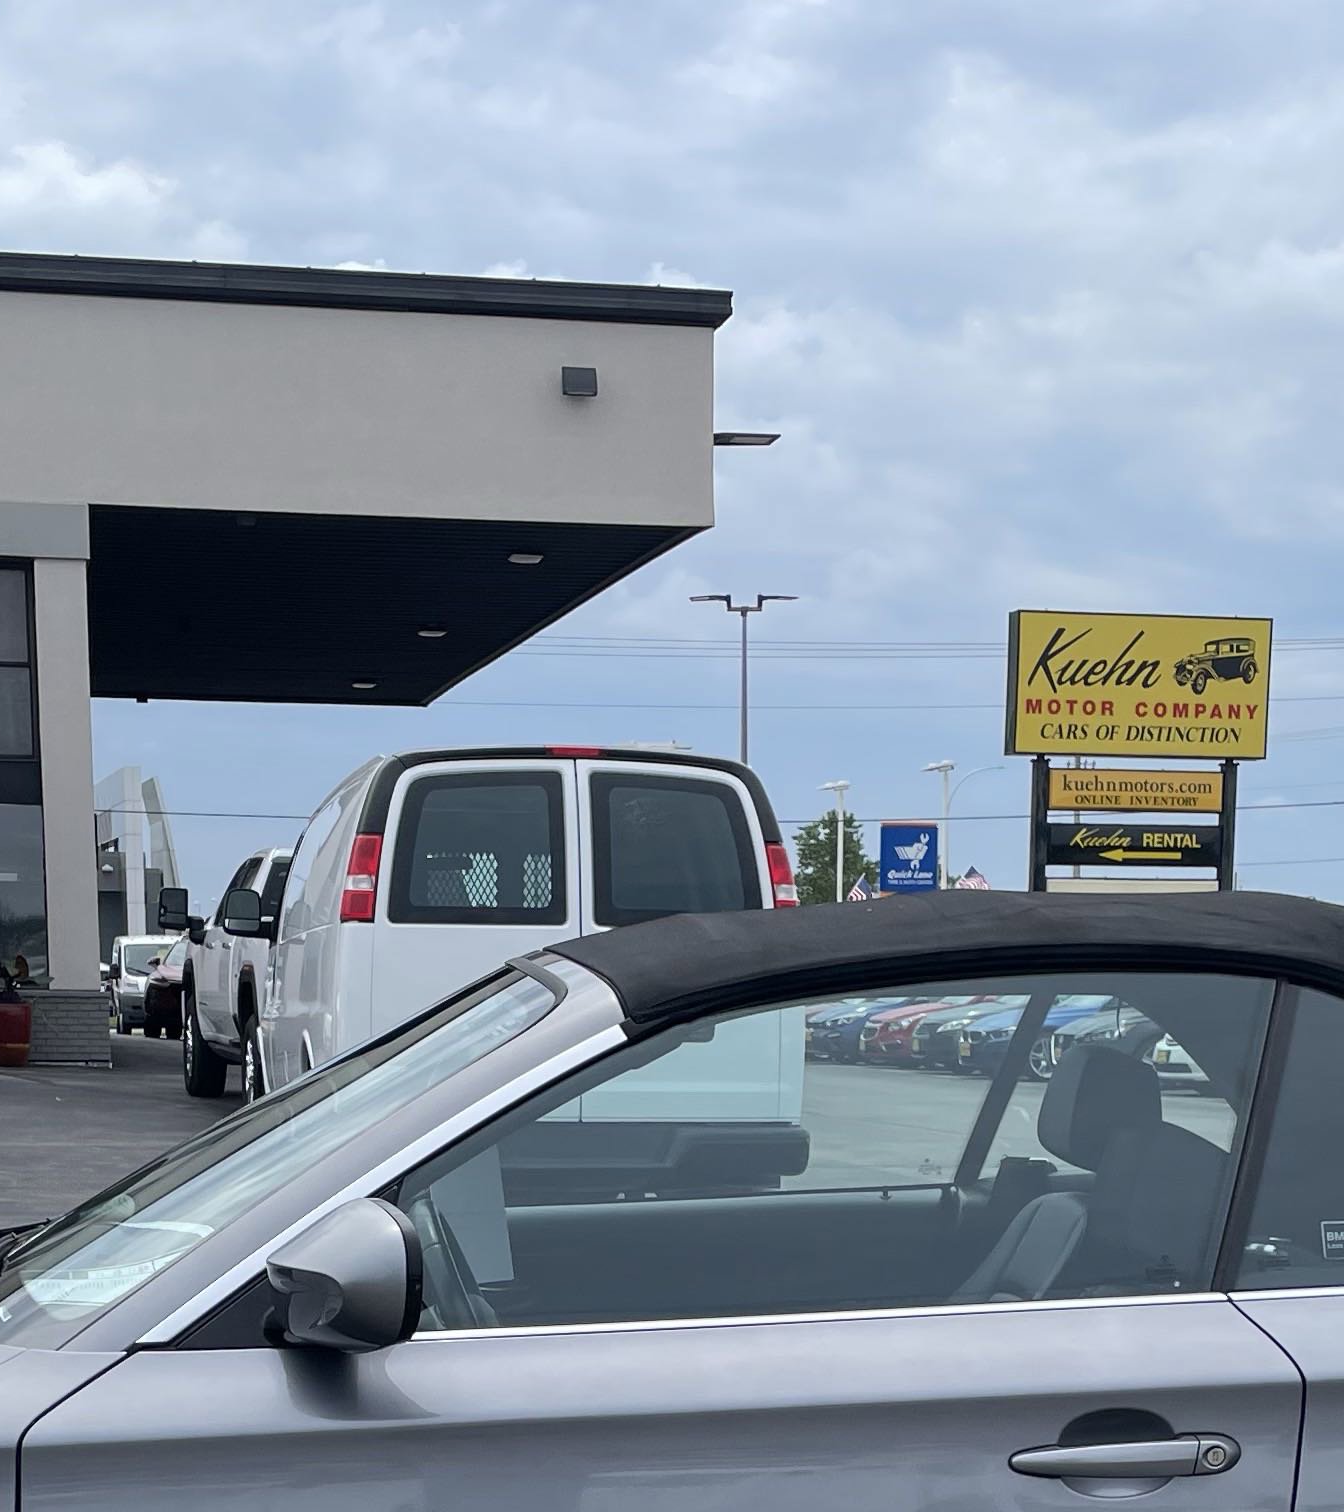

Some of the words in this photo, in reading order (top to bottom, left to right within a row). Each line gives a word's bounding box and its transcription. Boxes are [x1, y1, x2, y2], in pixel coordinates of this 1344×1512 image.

[1027, 627, 1162, 694] Kuehn
[1025, 698, 1115, 717] MOTOR
[1135, 701, 1259, 720] COMPANY
[1040, 723, 1088, 740] CARS
[1095, 724, 1121, 741] OF
[1125, 725, 1242, 744] DISTINCTION
[1062, 774, 1213, 795] kuehnmotors.com
[1074, 794, 1122, 806] ONLINE
[1129, 795, 1199, 807] INVENTORY
[1069, 826, 1132, 849] Kuehn
[1142, 833, 1201, 849] RENTAL
